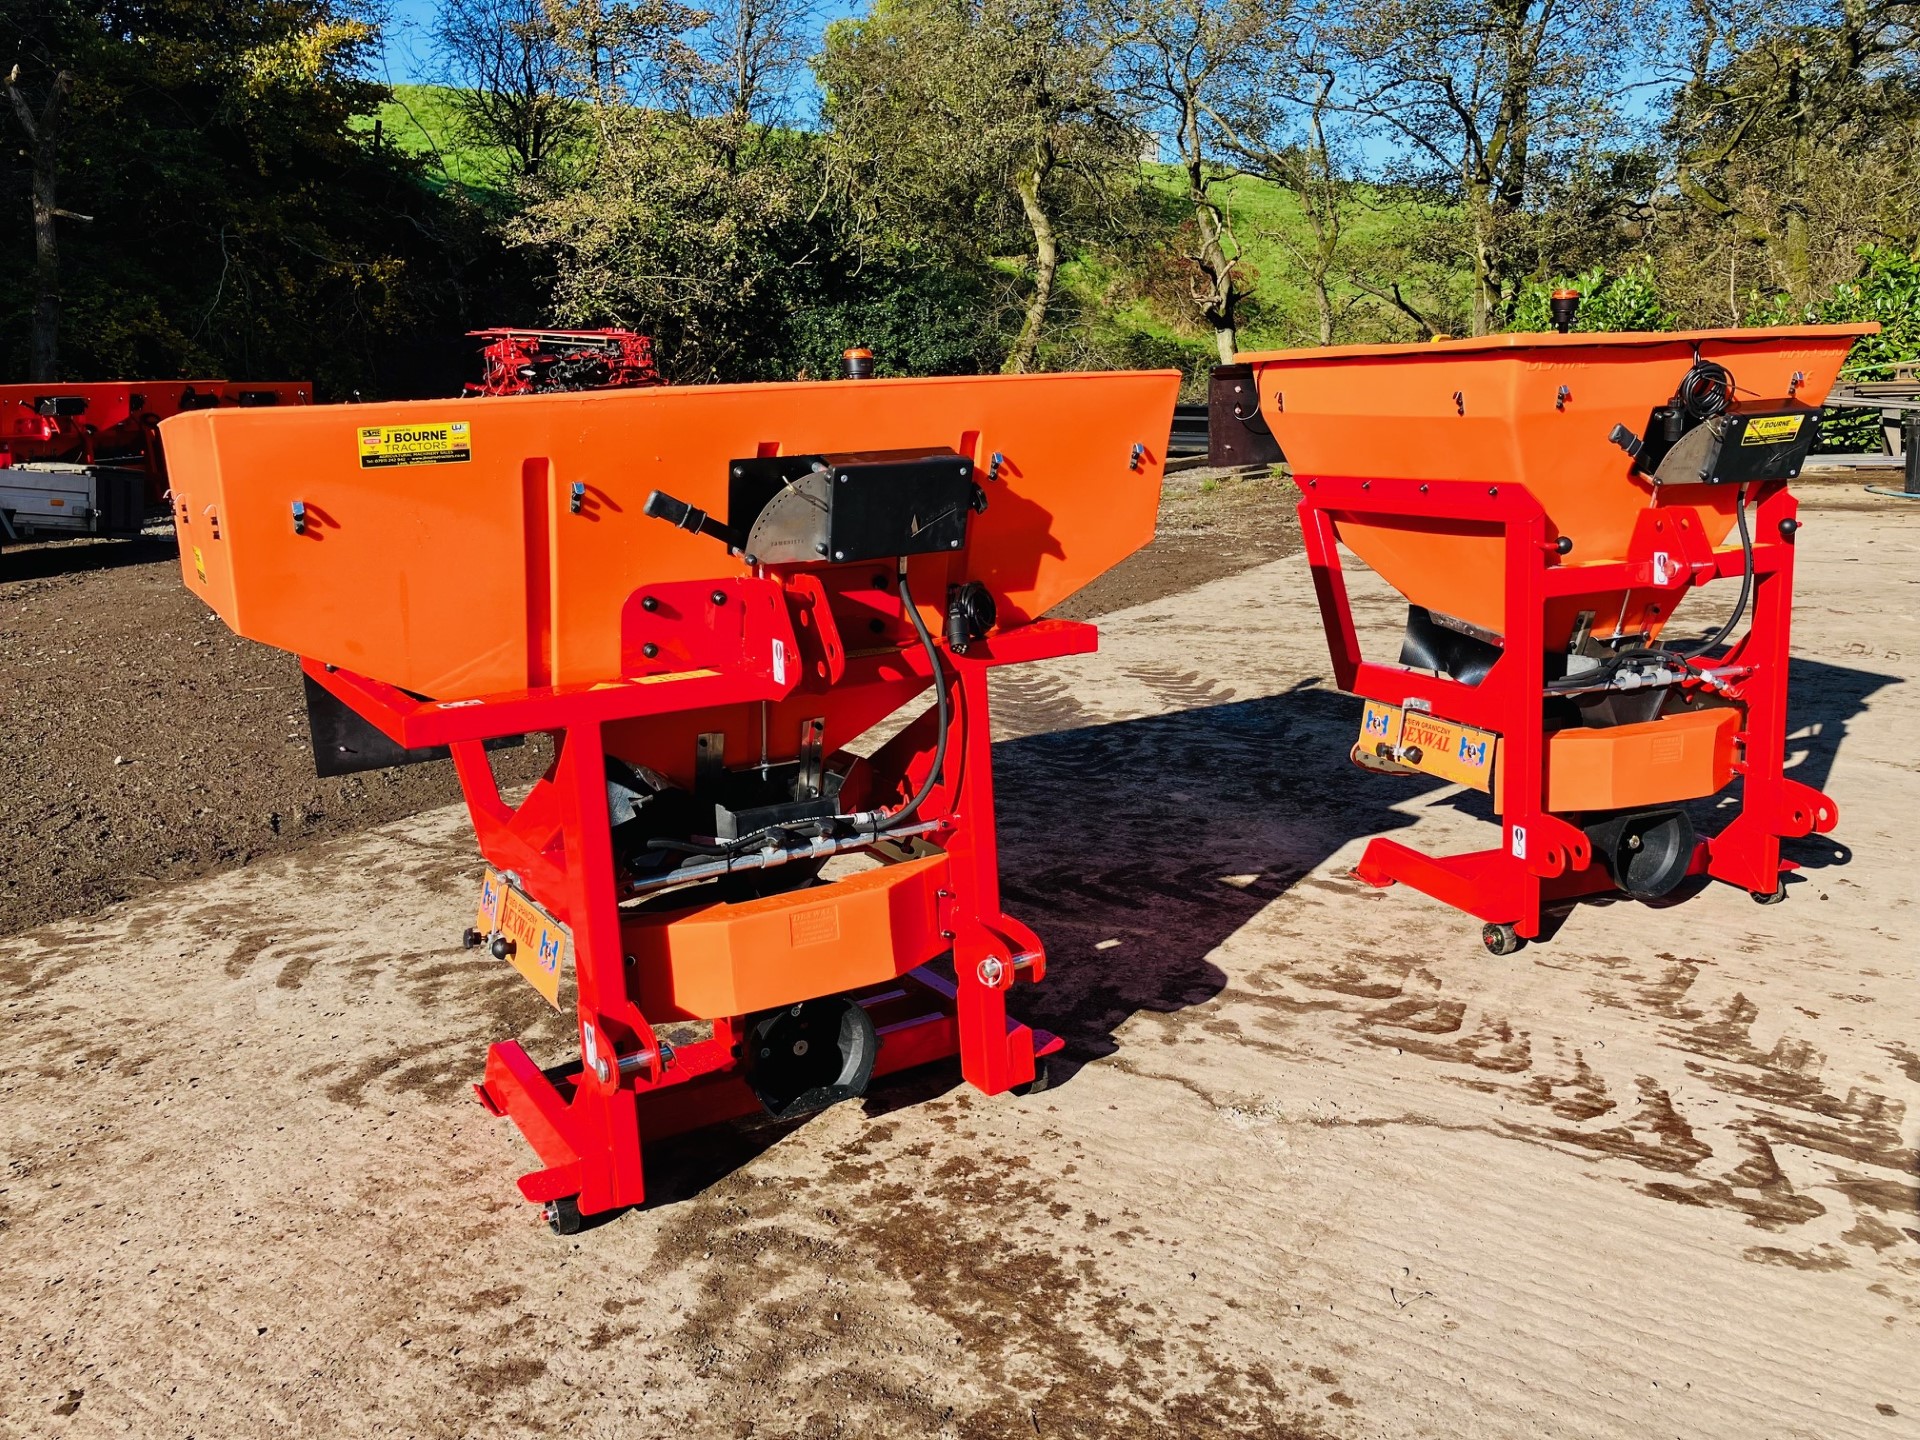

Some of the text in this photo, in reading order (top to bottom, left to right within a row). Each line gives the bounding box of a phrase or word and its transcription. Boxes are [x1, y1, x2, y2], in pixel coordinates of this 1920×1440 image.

[384, 433, 390, 444] J
[394, 430, 447, 443] BOURNE
[385, 441, 448, 453] TRACTORS
